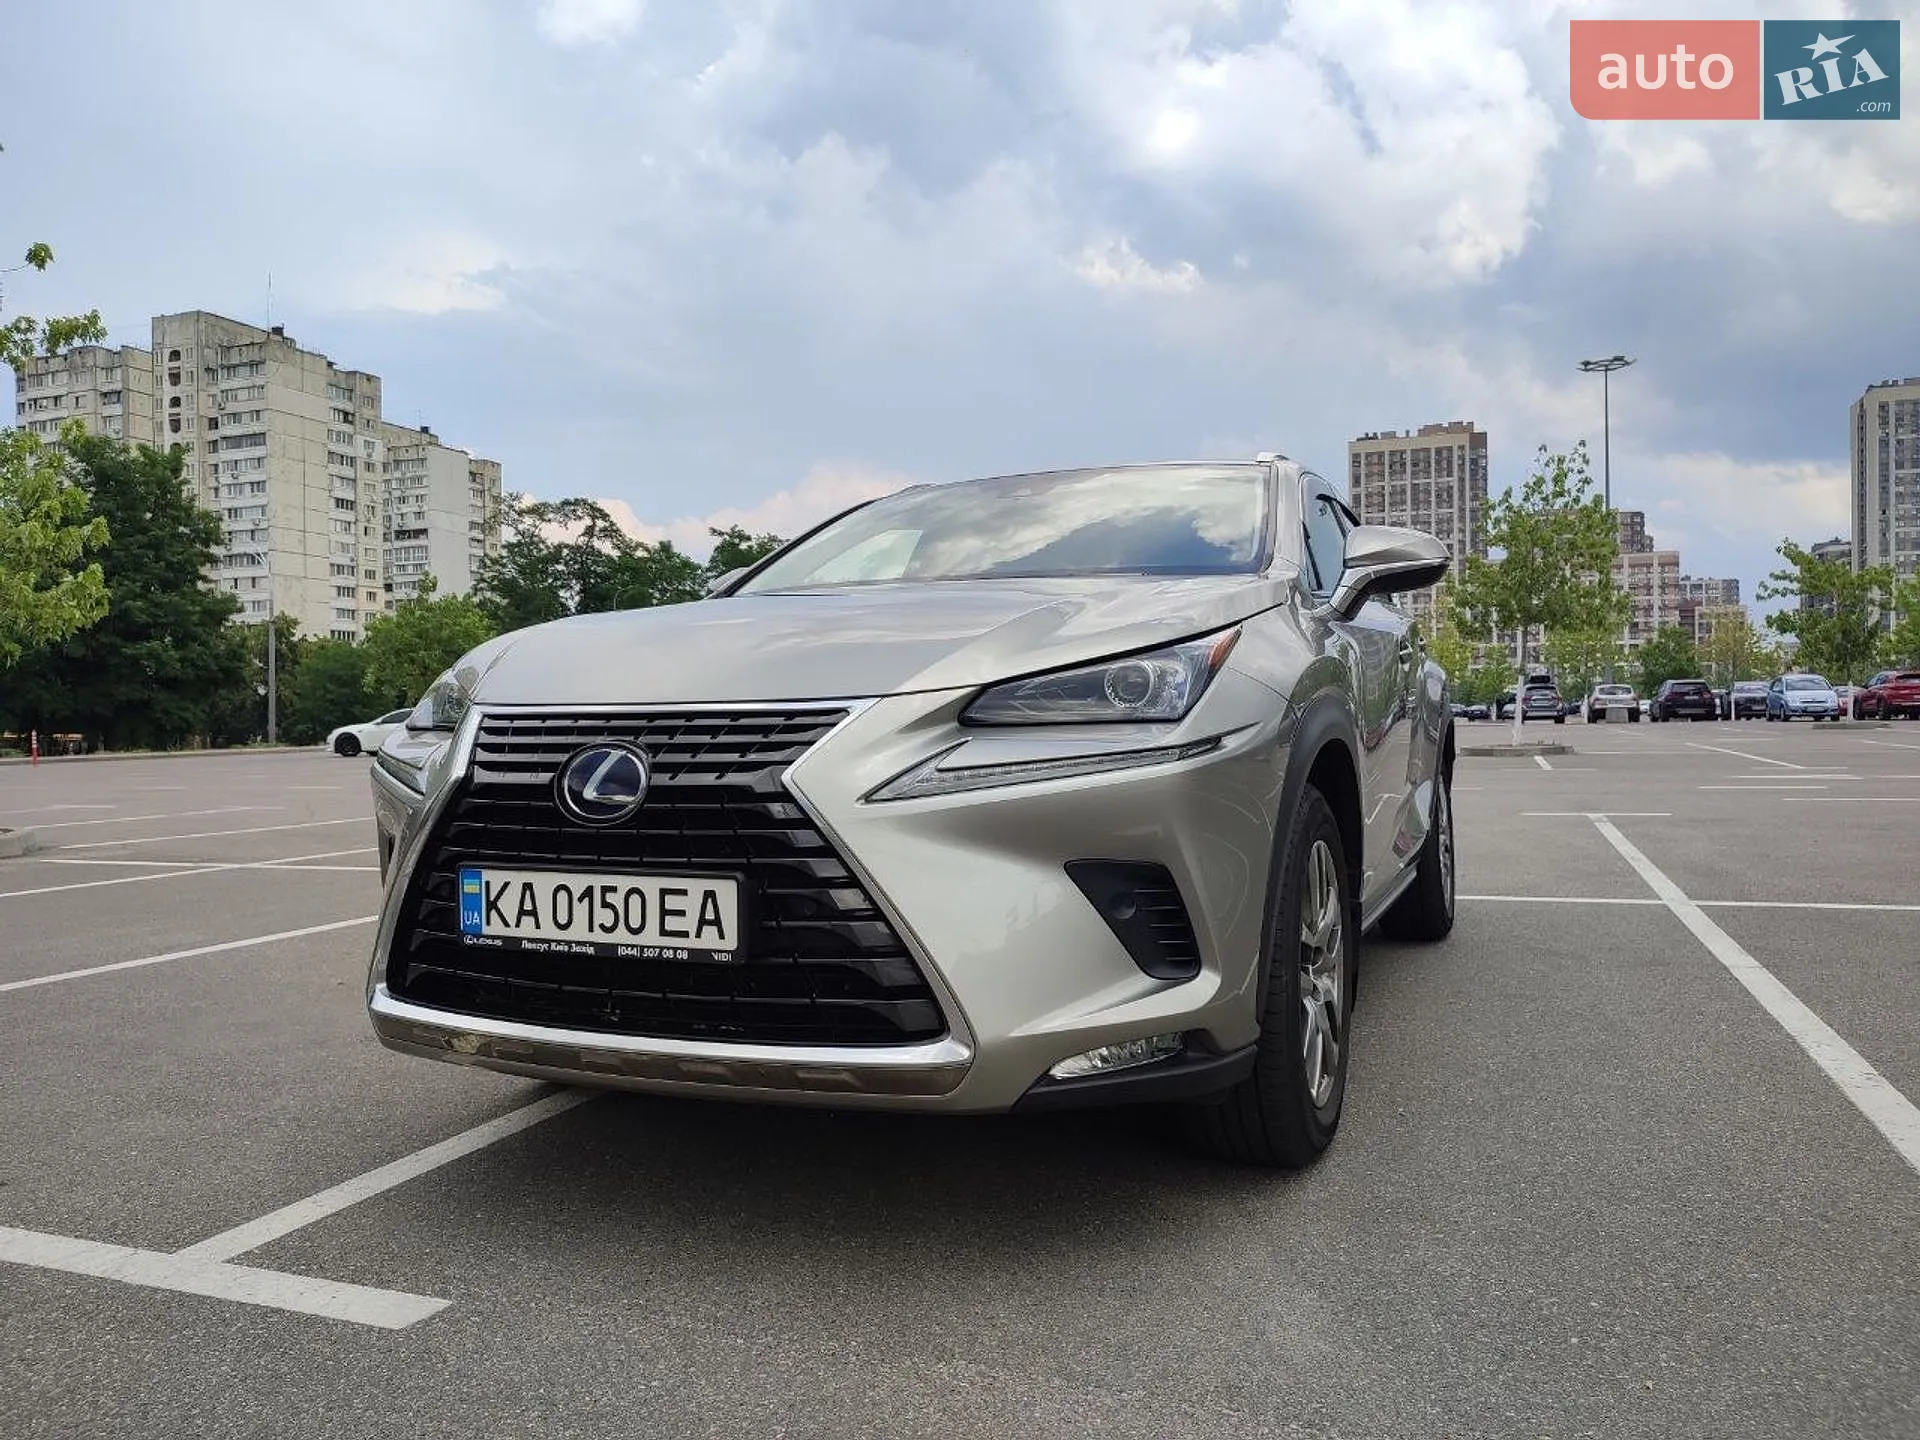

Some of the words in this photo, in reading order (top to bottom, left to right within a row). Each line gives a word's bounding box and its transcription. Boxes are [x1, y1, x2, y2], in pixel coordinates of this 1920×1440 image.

[464, 910, 480, 925] UA
[485, 880, 541, 930] KA
[552, 883, 647, 936] 0150
[658, 887, 726, 940] EA
